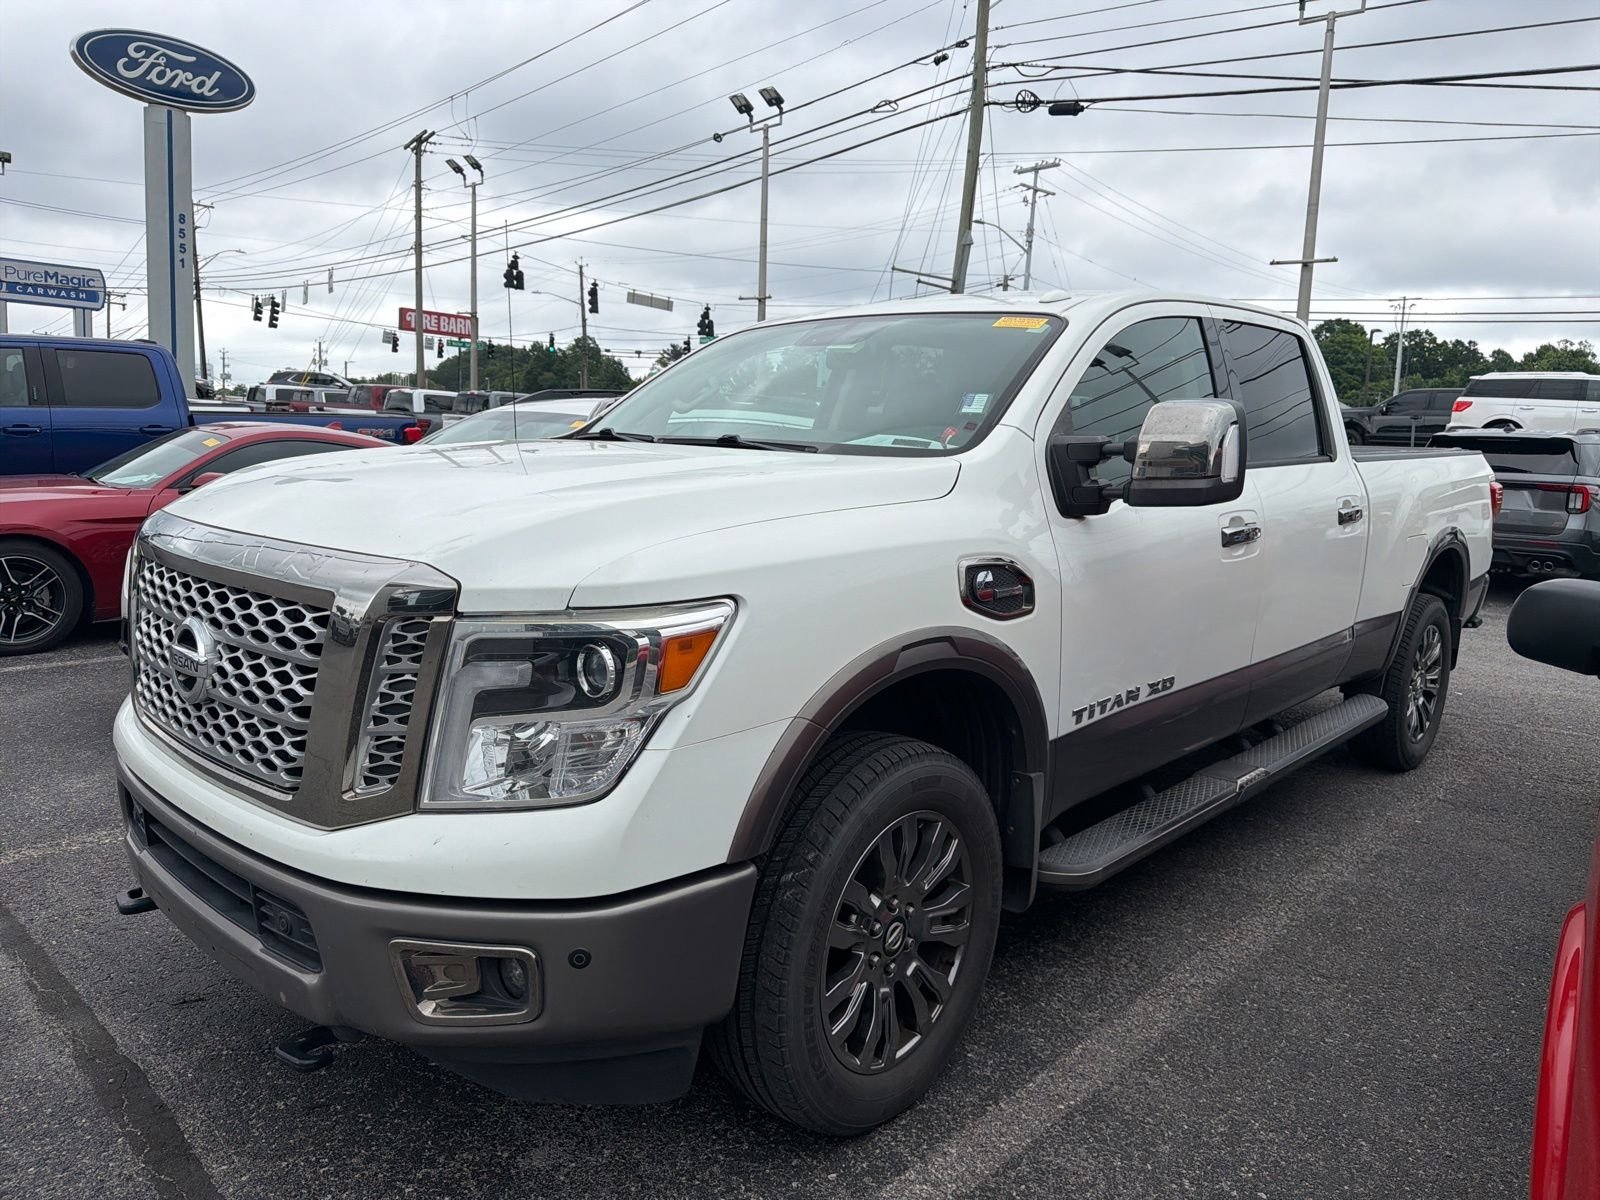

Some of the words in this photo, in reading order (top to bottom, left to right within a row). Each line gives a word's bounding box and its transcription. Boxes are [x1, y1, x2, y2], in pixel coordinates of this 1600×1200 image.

[116, 41, 222, 97] Ford
[178, 213, 187, 269] 8551
[4, 265, 96, 289] PureMagic
[16, 285, 86, 299] CARWASH
[405, 311, 438, 331] TRE
[1072, 686, 1141, 725] TITAN
[1146, 675, 1175, 698] XD
